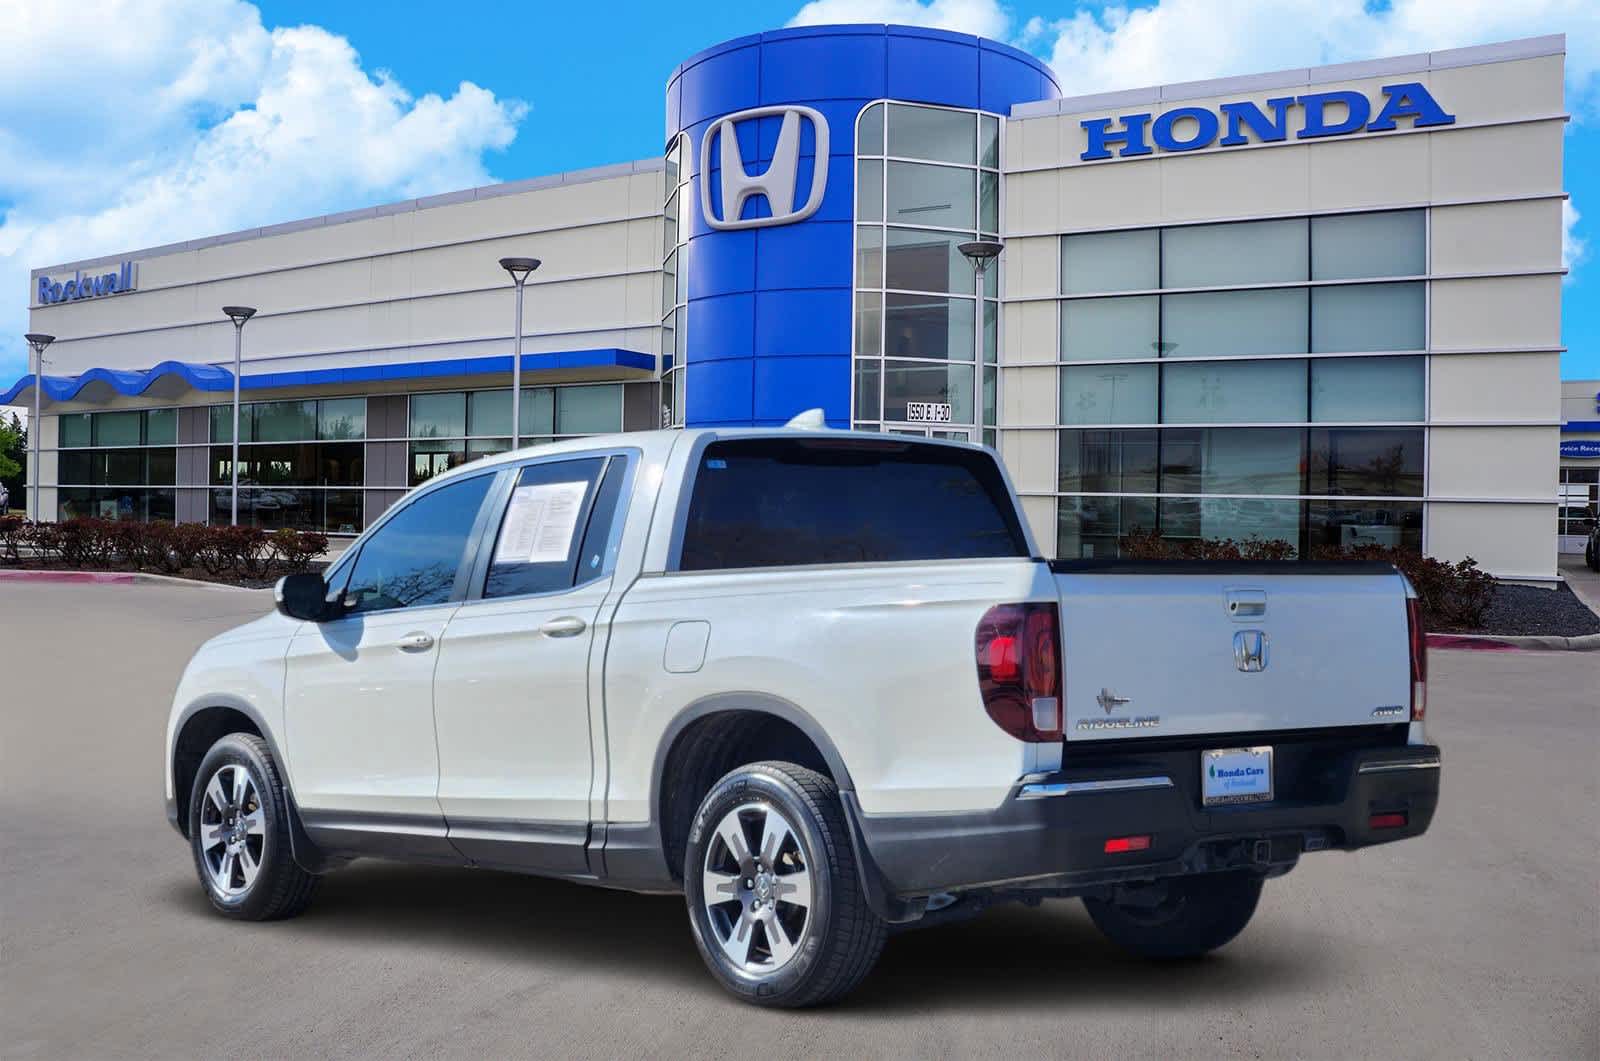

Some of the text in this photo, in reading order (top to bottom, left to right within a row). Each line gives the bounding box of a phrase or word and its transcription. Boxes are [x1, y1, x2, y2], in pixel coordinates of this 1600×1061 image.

[1080, 82, 1456, 161] HONDA
[38, 260, 133, 304] Rockwell
[908, 404, 924, 419] 1550
[1075, 715, 1161, 730] RIDGELINE
[1217, 767, 1264, 778] Honda Cars
